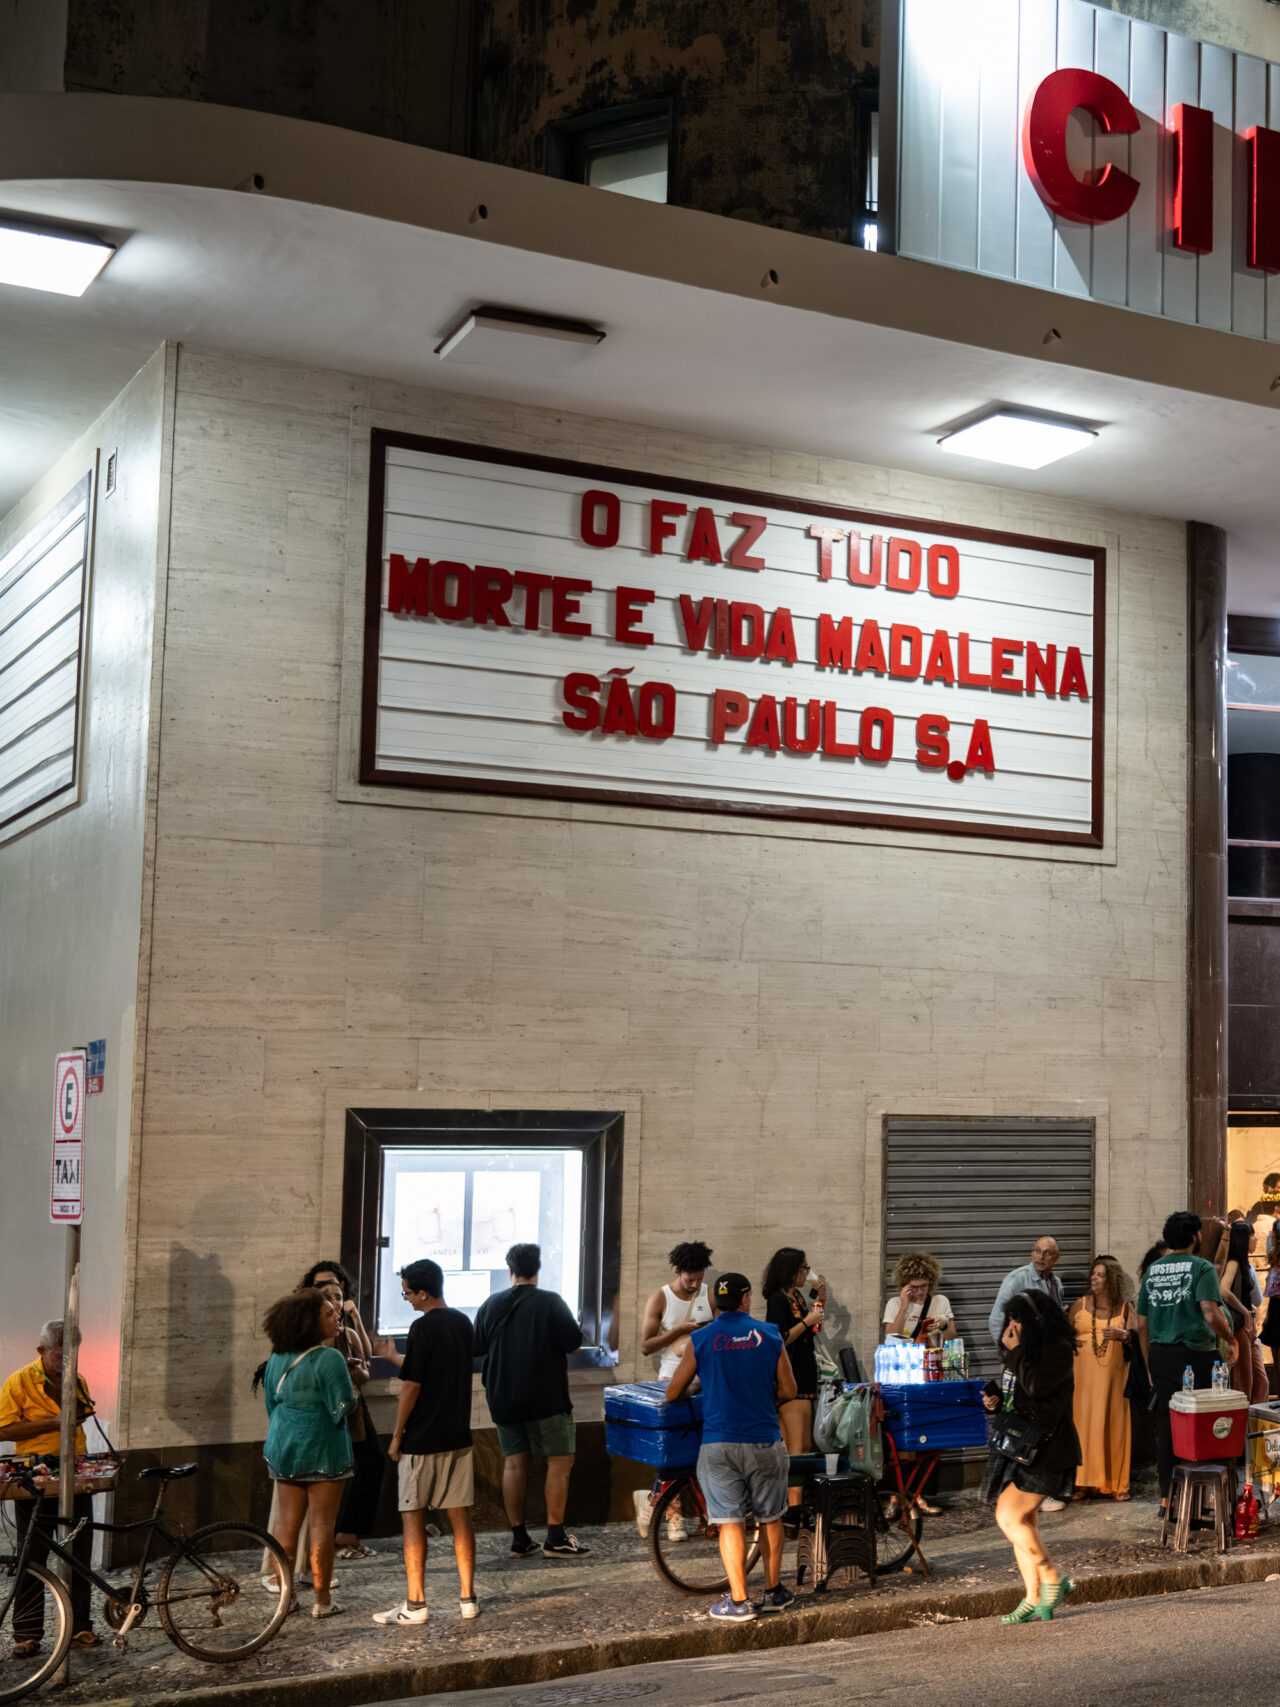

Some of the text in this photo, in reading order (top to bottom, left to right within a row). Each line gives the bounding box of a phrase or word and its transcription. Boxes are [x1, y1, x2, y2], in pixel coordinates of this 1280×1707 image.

[581, 490, 961, 599] O FAZ TUDO
[388, 553, 1090, 699] MORTE E VIDA MADALENA
[562, 666, 677, 739] SÃO
[711, 688, 894, 762] PAULO
[65, 1082, 74, 1120] E
[55, 1159, 80, 1184] TAXI
